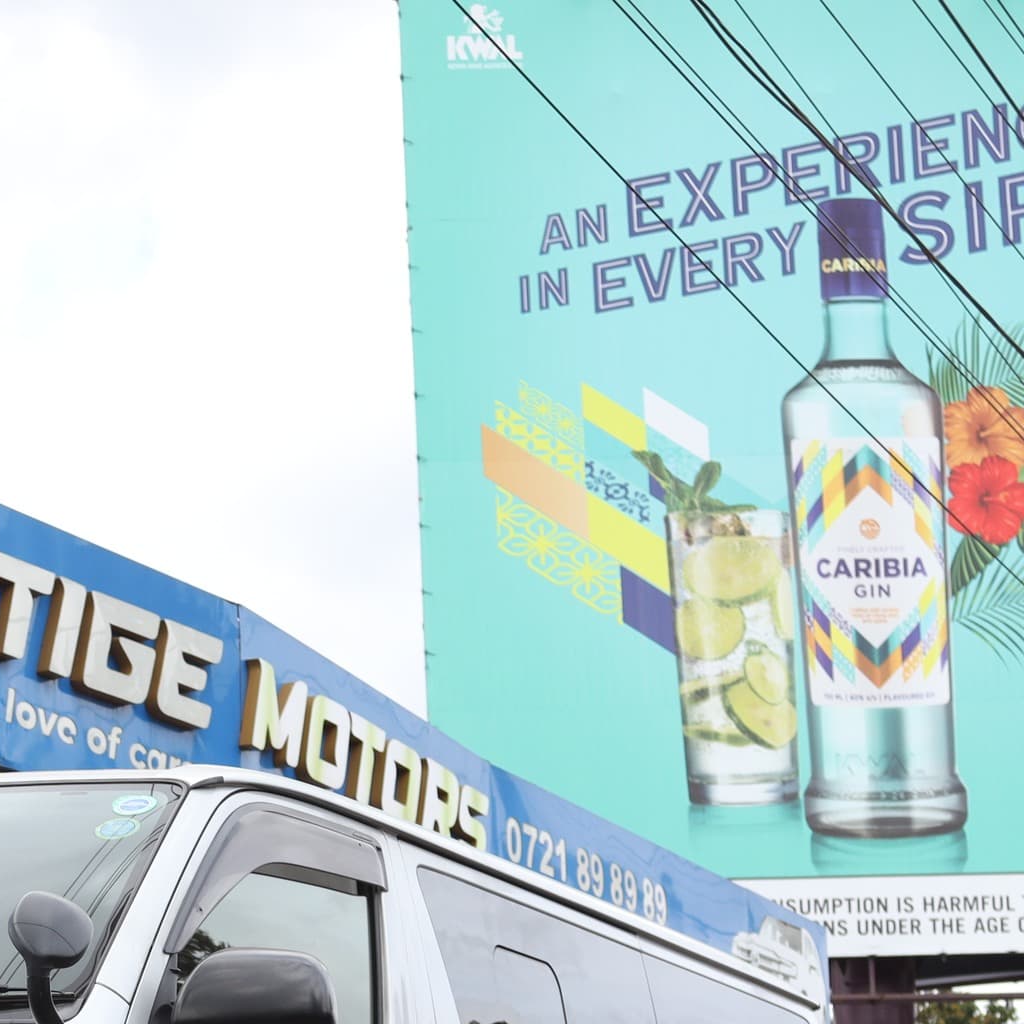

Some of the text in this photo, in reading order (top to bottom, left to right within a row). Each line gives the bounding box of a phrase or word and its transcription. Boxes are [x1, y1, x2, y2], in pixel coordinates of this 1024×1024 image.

[446, 34, 523, 61] KWAL
[539, 102, 1024, 255] AN EXPERIEN
[519, 267, 570, 314] IN
[593, 220, 807, 314] EVERY
[816, 556, 928, 579] CARIBIA
[854, 583, 892, 598] GIN
[4, 687, 78, 745] love
[87, 725, 123, 760] of
[240, 657, 490, 852] MOTORS
[506, 816, 669, 927] 0721 89 89 89
[778, 894, 1016, 915] SUMPTION IS HARMFUL
[857, 918, 922, 936] UNDER
[930, 917, 966, 934] THE
[974, 916, 1012, 934] AGE
